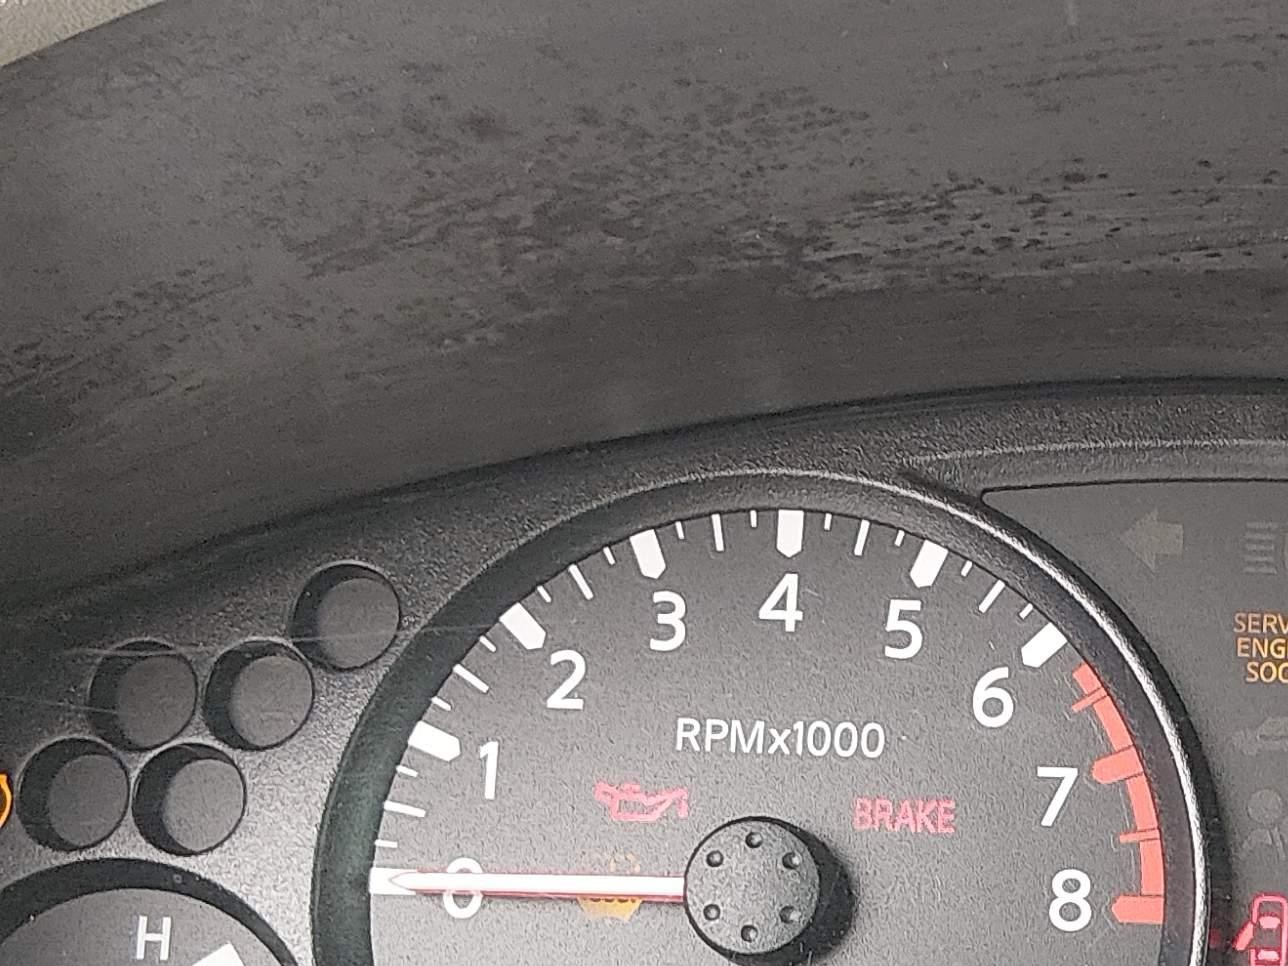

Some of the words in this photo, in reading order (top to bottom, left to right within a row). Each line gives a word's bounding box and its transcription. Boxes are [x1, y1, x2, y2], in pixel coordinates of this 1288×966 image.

[649, 590, 687, 652] 3
[758, 573, 804, 633] 4
[884, 599, 924, 660] 5
[547, 650, 587, 710] 2
[973, 667, 1015, 728] 6
[675, 717, 886, 759] RPMx1000
[478, 740, 500, 800] 1
[1036, 767, 1079, 827] 7
[852, 797, 956, 834] BRAKE
[442, 857, 484, 919] 0
[1050, 870, 1092, 932] 8
[136, 915, 172, 961] H
